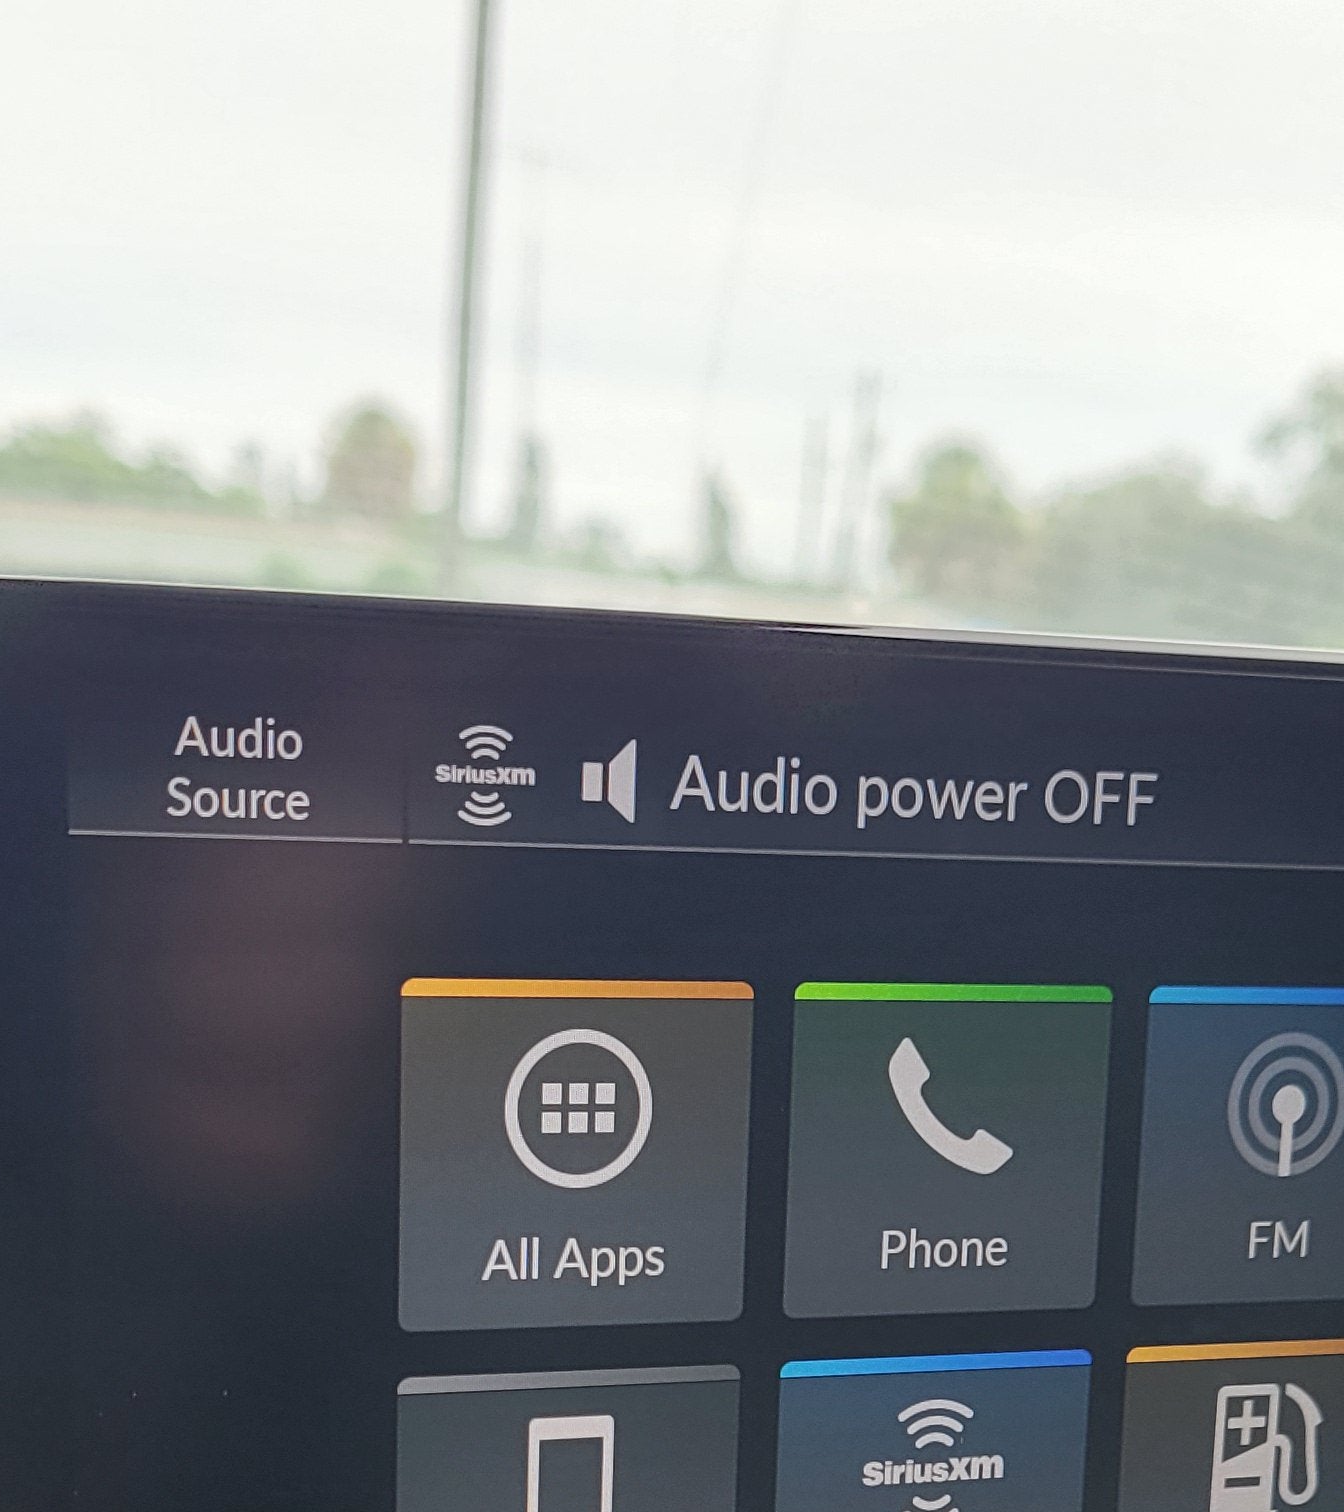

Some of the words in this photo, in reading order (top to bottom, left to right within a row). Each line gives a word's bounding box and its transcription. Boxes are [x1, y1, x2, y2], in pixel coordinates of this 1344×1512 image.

[175, 716, 303, 761] Audio
[166, 776, 310, 821] Source
[670, 755, 837, 816] Audio
[857, 775, 1028, 829] power
[1045, 769, 1159, 826] OFF
[483, 1238, 539, 1281] All
[554, 1239, 665, 1286] Apps
[880, 1229, 1008, 1270] Phone
[1247, 1221, 1310, 1259] FM
